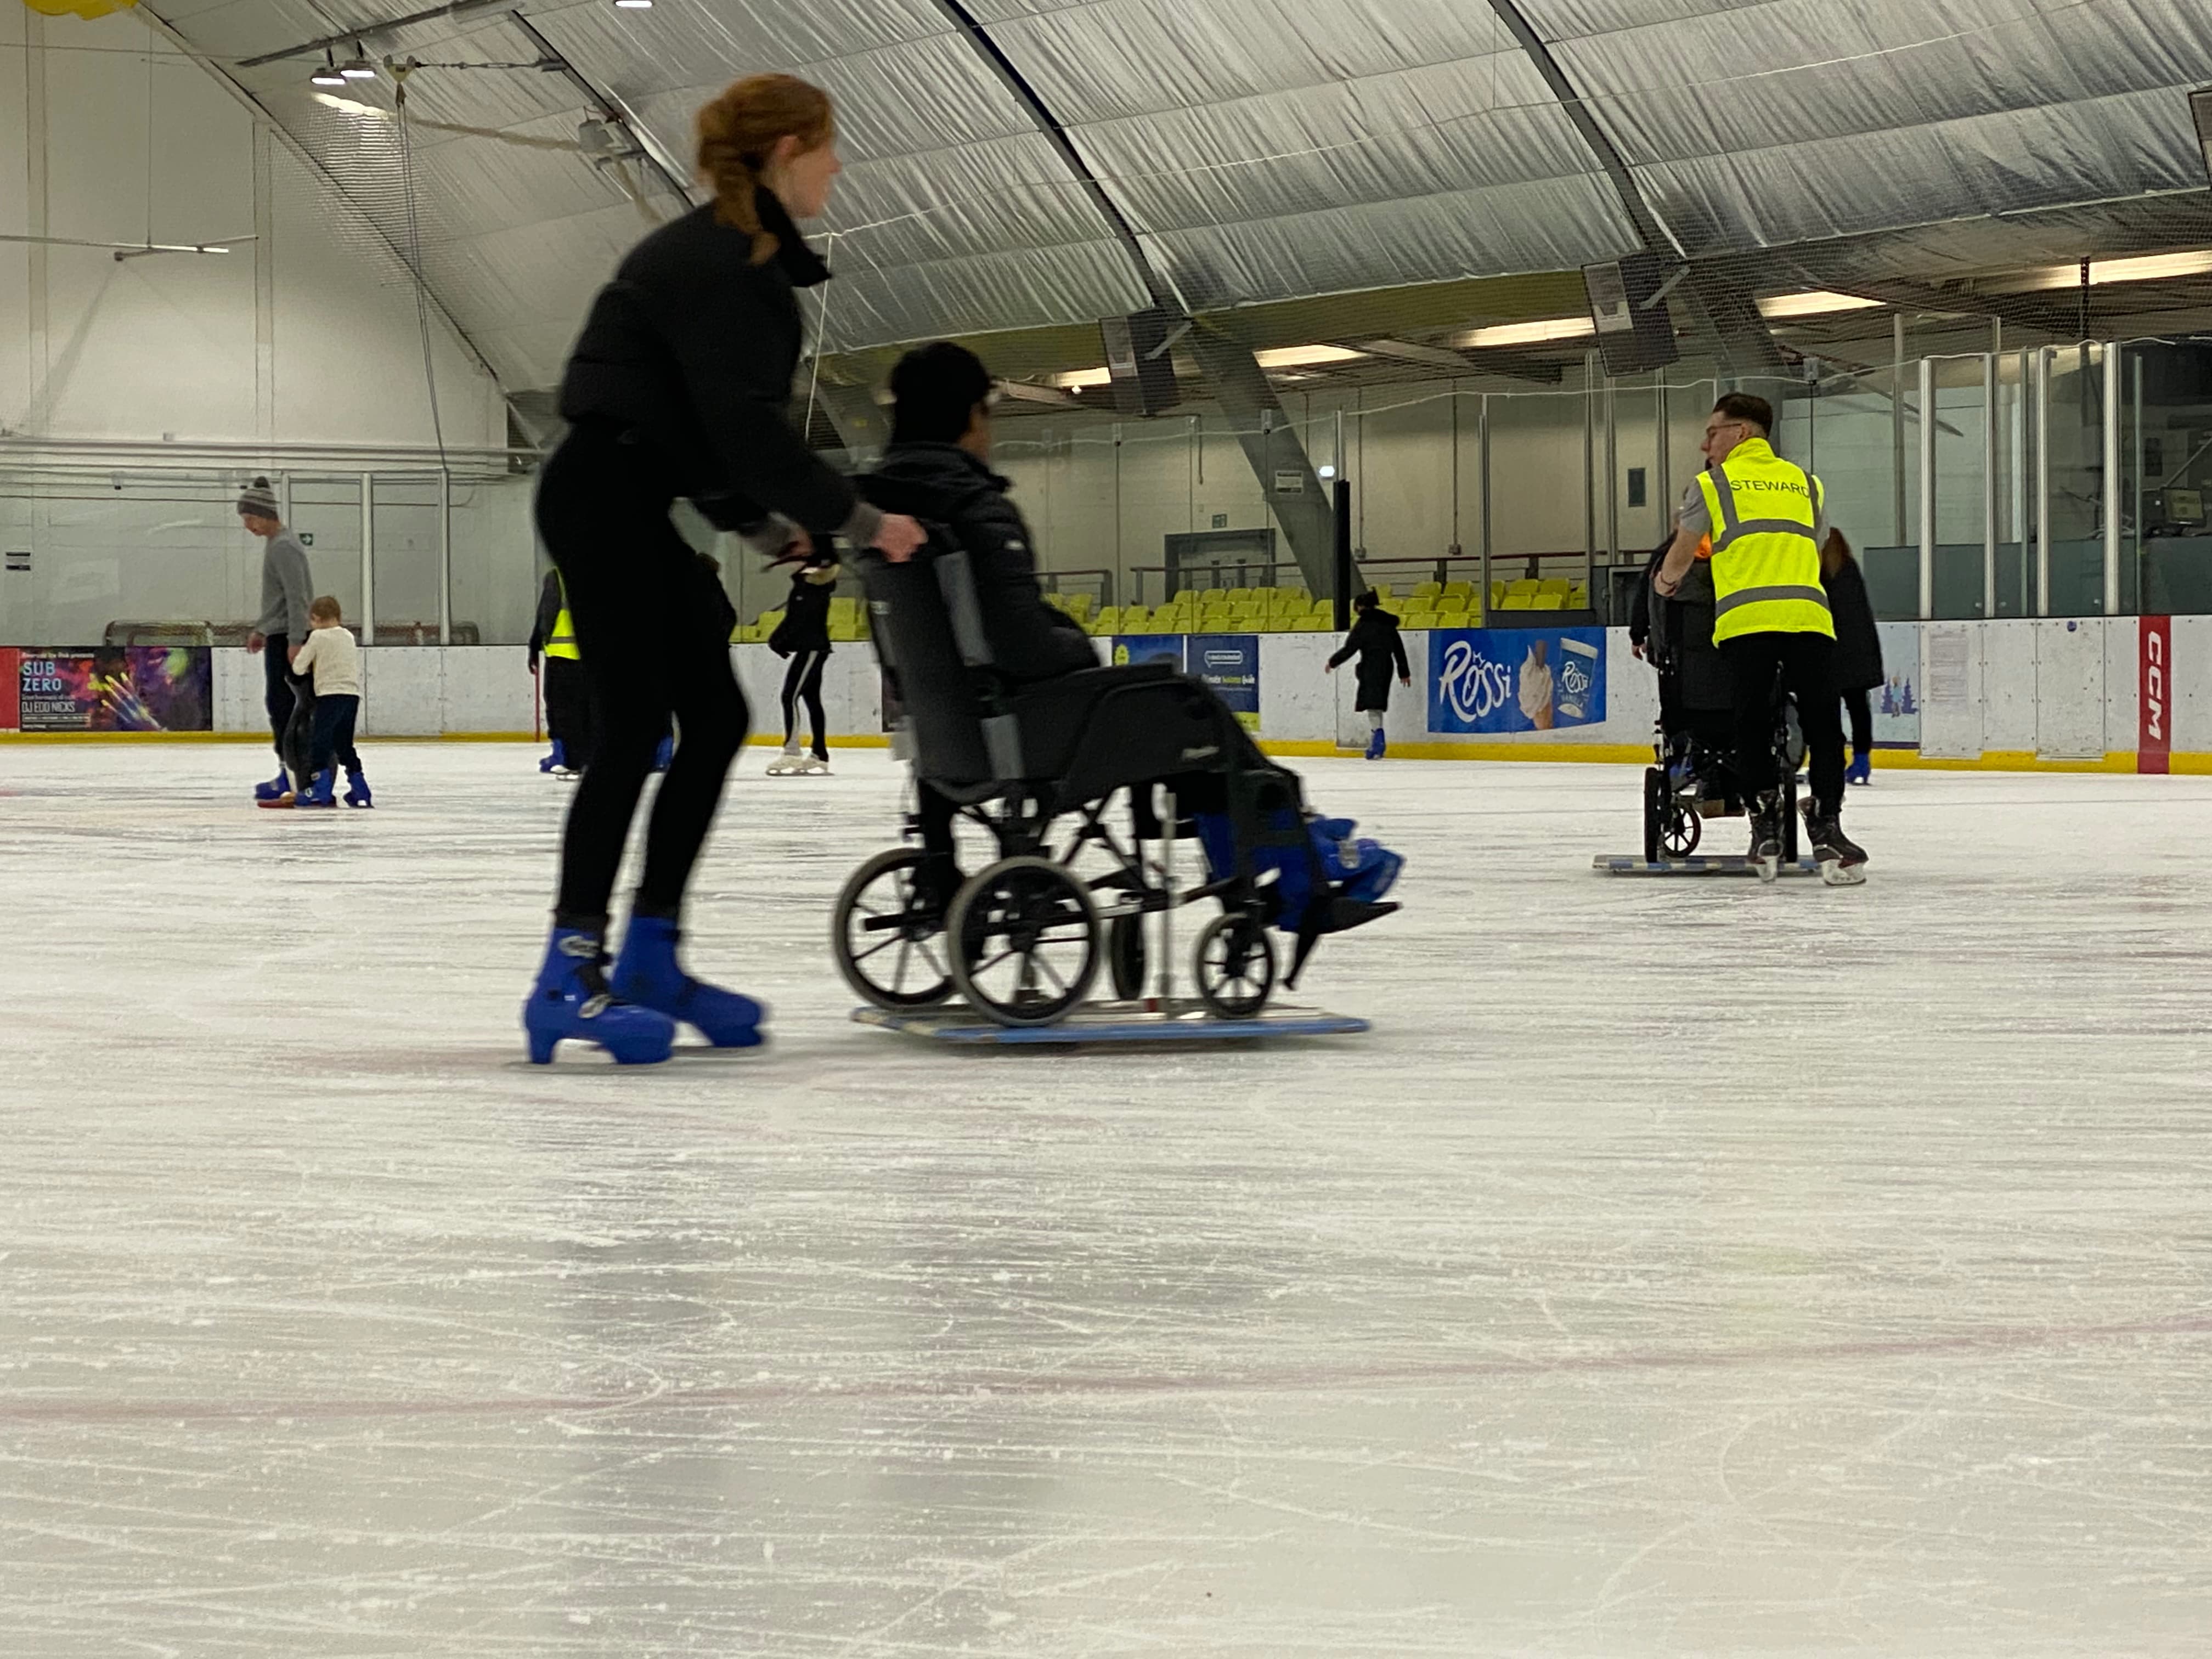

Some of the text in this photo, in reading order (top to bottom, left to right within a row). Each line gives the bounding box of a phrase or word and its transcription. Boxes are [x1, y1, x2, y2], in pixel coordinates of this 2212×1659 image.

[22, 661, 55, 675] SUB
[22, 678, 62, 691] ZERO
[2148, 630, 2162, 740] CCM
